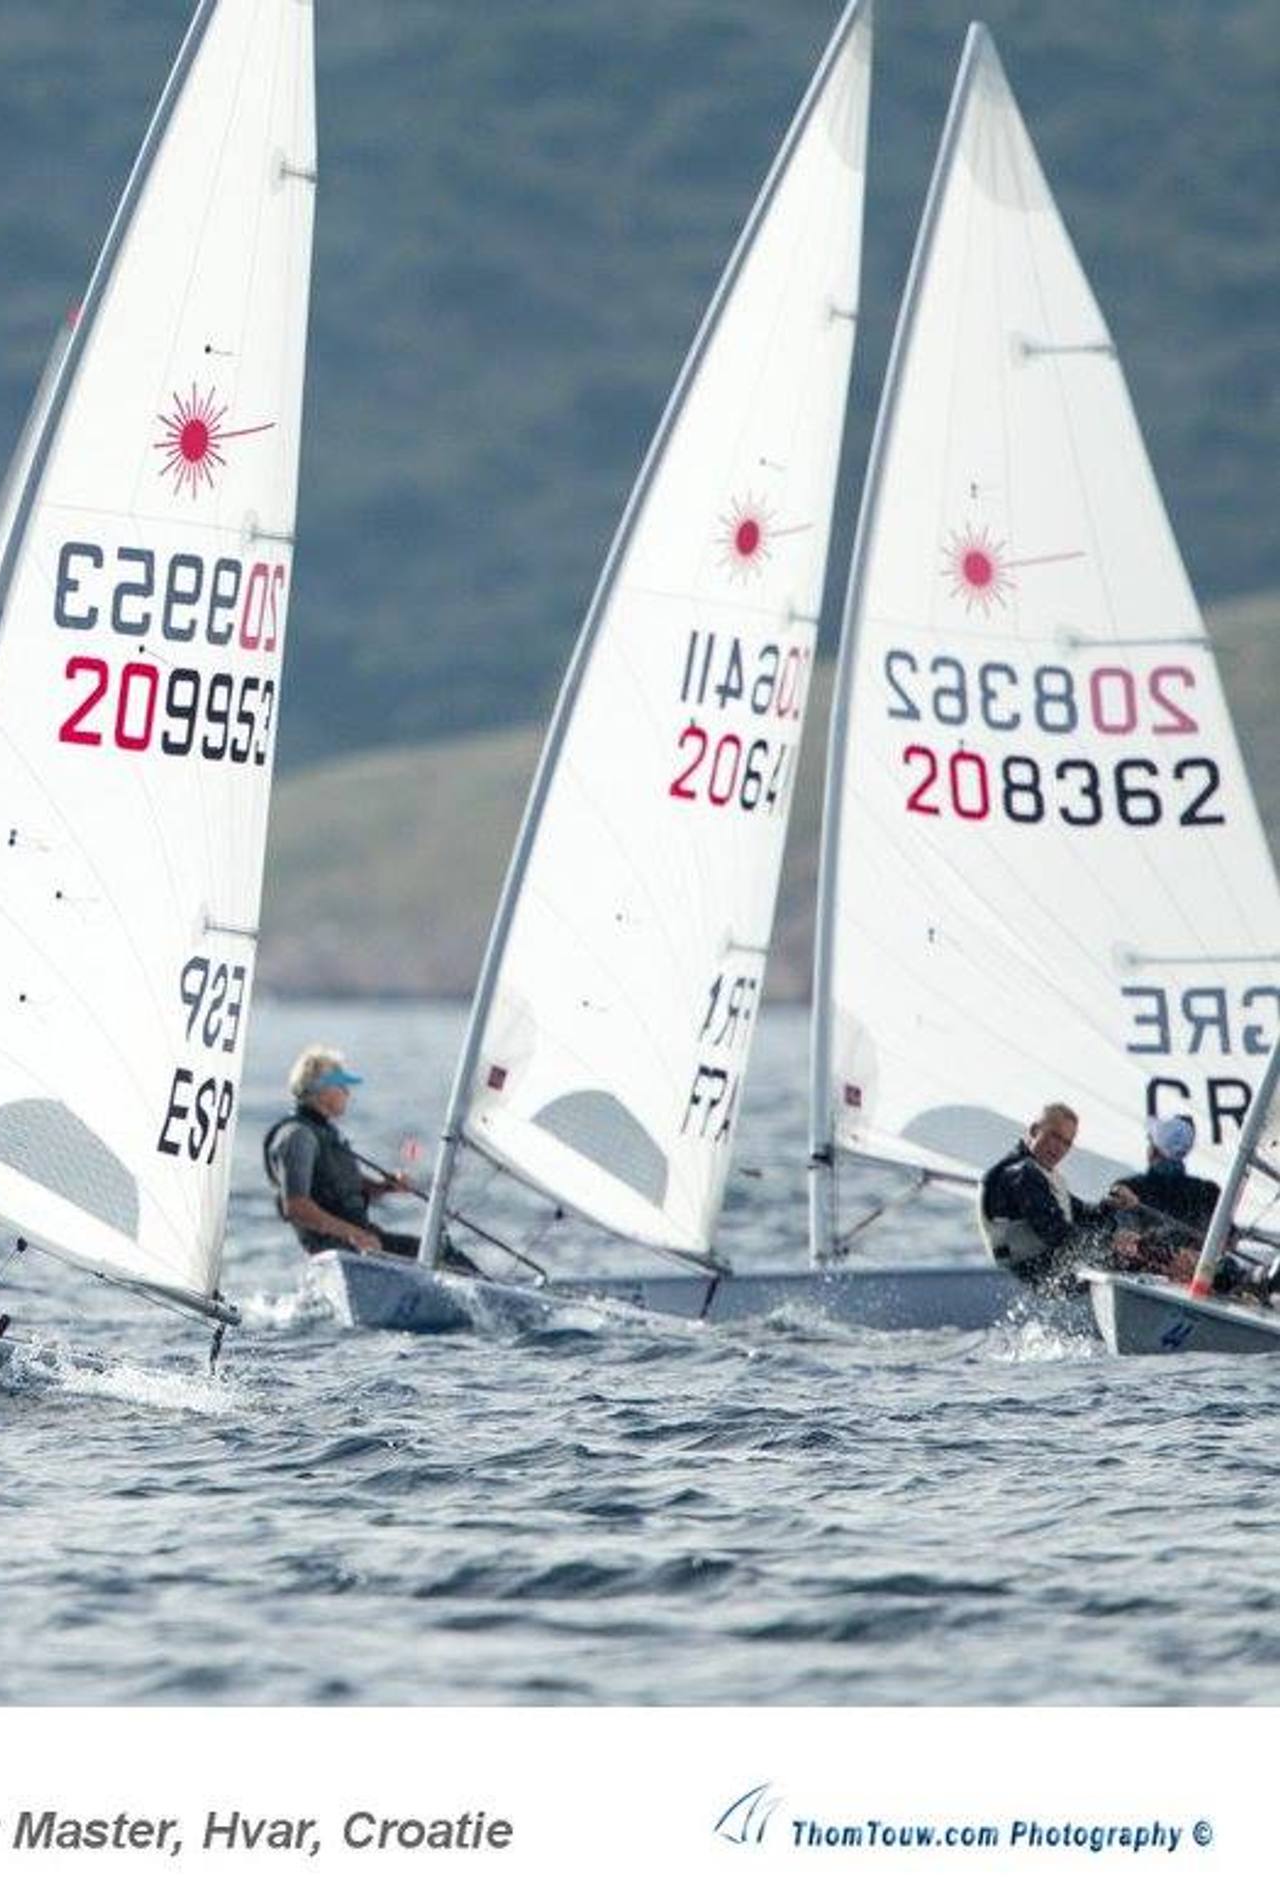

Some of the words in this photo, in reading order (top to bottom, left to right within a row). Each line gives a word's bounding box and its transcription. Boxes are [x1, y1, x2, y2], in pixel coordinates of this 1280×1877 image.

[59, 656, 274, 766] 209953
[903, 745, 1225, 827] 208362
[157, 1067, 234, 1164] ESP
